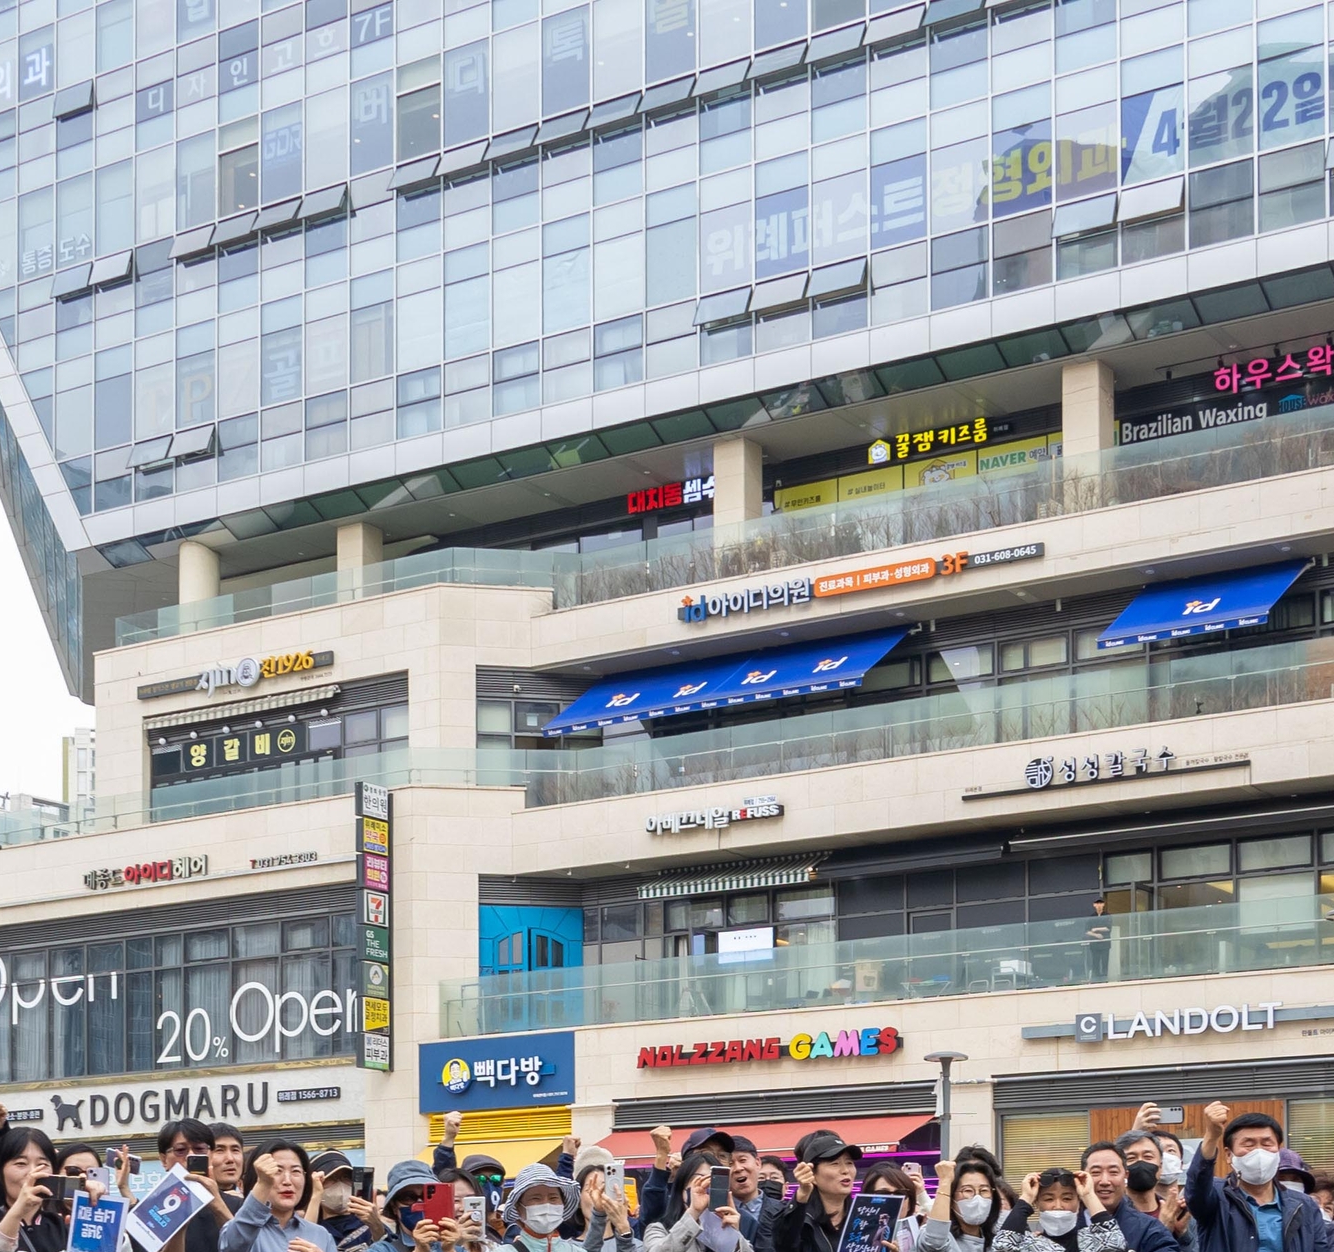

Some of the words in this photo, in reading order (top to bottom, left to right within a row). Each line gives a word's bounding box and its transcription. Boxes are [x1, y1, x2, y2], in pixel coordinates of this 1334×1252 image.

[938, 418, 988, 445] 키즈룸
[1121, 411, 1193, 445] Brazilian
[1198, 401, 1268, 431] Waxing
[979, 450, 1027, 472] NAVER
[818, 576, 854, 593] 진료과목
[940, 551, 969, 577] 3F
[973, 545, 1037, 566] 031-608-0645
[1182, 597, 1222, 616] id
[812, 656, 848, 673] id
[741, 670, 777, 685] id
[672, 681, 707, 698] id
[605, 693, 640, 708] id
[1057, 745, 1177, 783] 성성칼국수
[731, 804, 780, 820] REFUSS
[365, 938, 380, 949] THE
[365, 946, 388, 959] FRESH
[1107, 1001, 1284, 1041] LANDOLT
[365, 1048, 388, 1063] 피부과
[636, 1035, 781, 1069] NOLZZANG
[788, 1026, 900, 1061] GAMES
[473, 1055, 543, 1088] 빽다방
[298, 1087, 338, 1100] 1566-8713
[89, 1081, 270, 1127] DOGMARU
